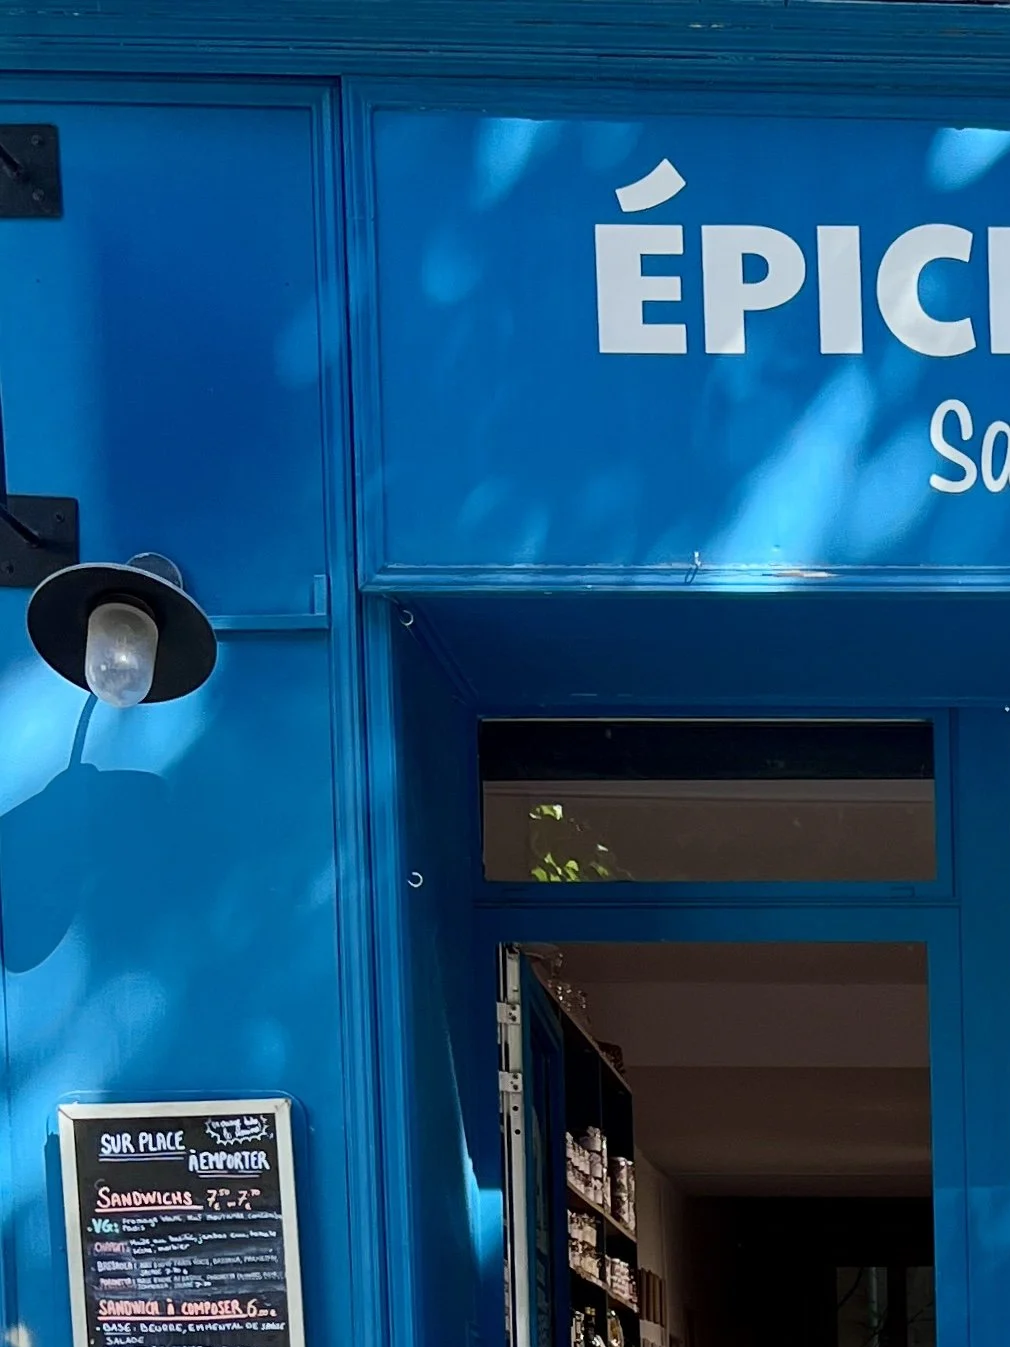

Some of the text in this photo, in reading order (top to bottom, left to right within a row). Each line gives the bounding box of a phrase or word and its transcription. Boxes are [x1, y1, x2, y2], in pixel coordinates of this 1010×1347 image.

[100, 1130, 186, 1154] SUR PLACE
[199, 1150, 271, 1171] EMPORTER
[97, 1186, 193, 1207] SANDWICHS
[99, 1300, 159, 1316] SANDWICH
[181, 1299, 243, 1316] COMPOSER
[188, 1322, 243, 1333] EMMENTAL
[106, 1336, 145, 1346] SALADE
